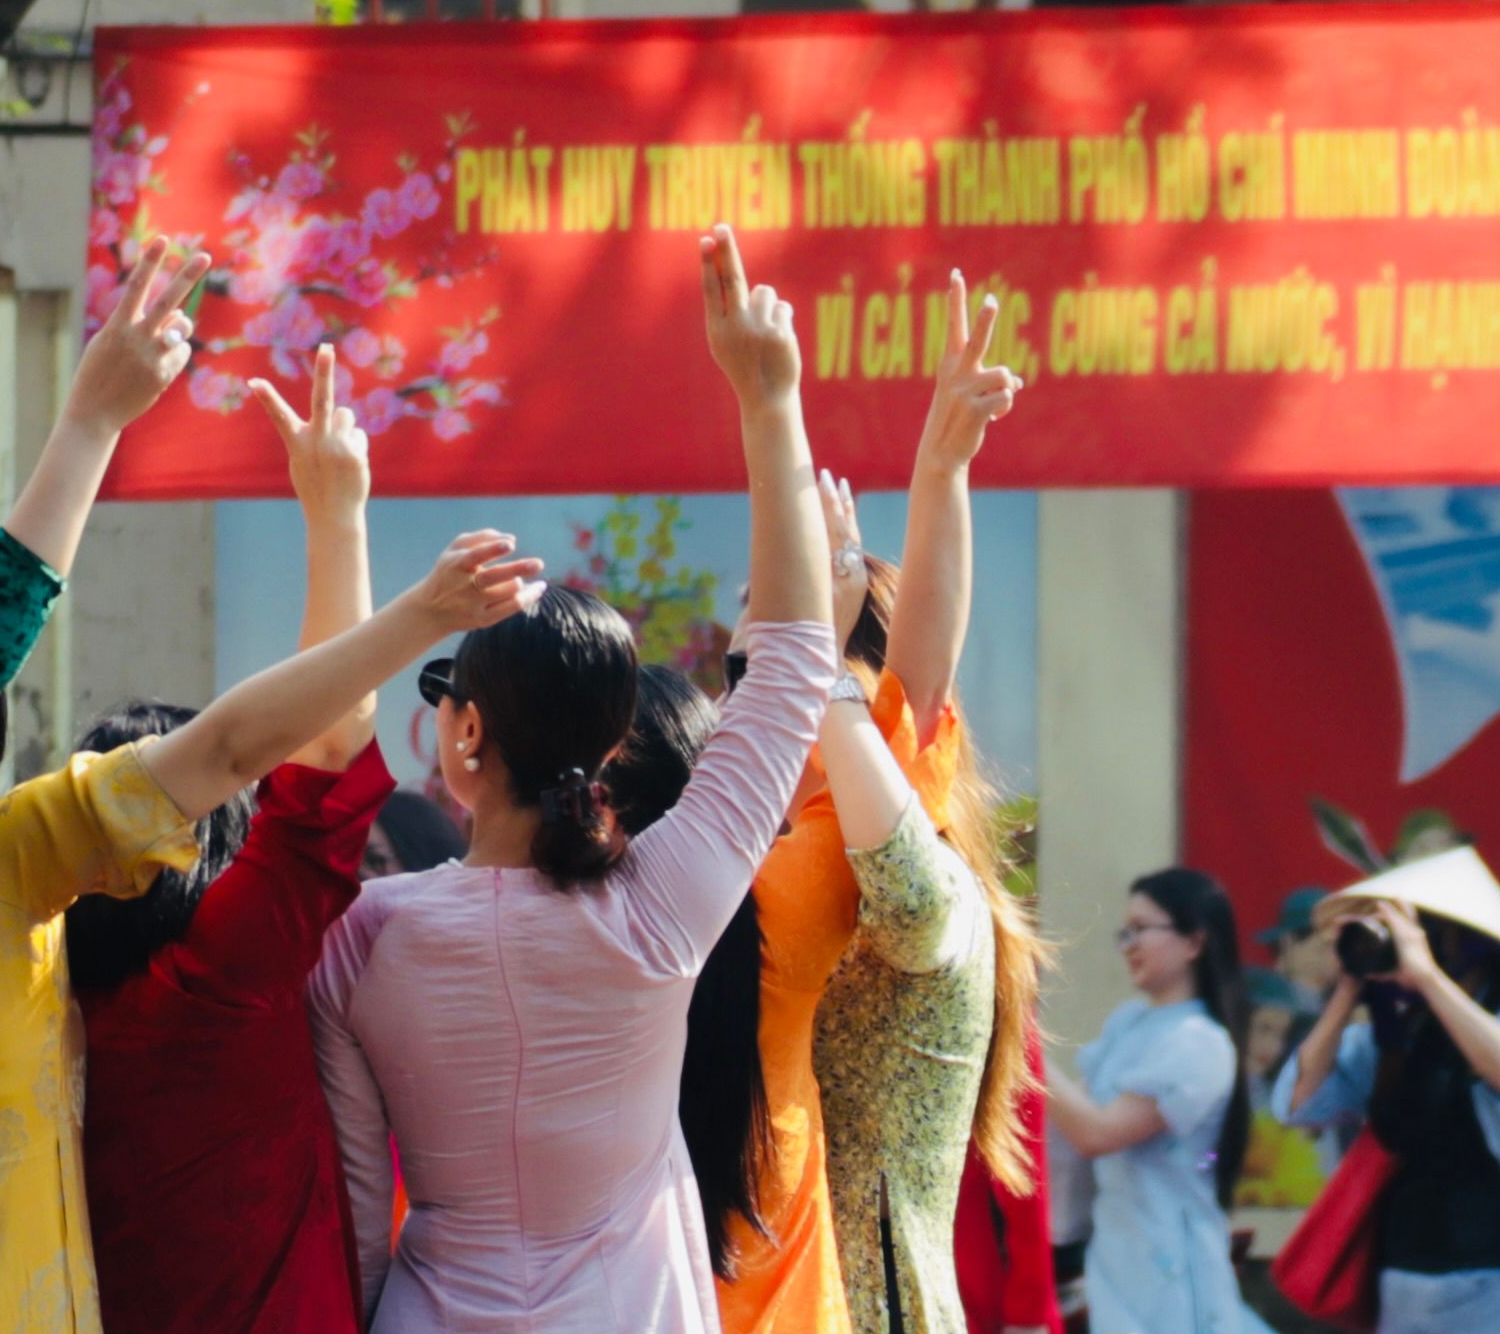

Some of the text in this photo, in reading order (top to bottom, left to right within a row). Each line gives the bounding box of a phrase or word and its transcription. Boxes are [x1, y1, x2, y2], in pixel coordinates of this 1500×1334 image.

[455, 128, 553, 233] PHÁT
[562, 144, 636, 232] HUY
[799, 109, 926, 227] THỐNG
[933, 119, 1060, 227] THÀNH
[1068, 103, 1148, 225] PHỐ
[1219, 113, 1286, 222] CHÍ
[1294, 128, 1401, 220] MINH
[815, 273, 854, 380] VÌ
[862, 263, 914, 378] CẢ
[1051, 272, 1157, 376] CÙNG
[1167, 256, 1218, 375] CẢ
[1356, 262, 1397, 372] VÌ
